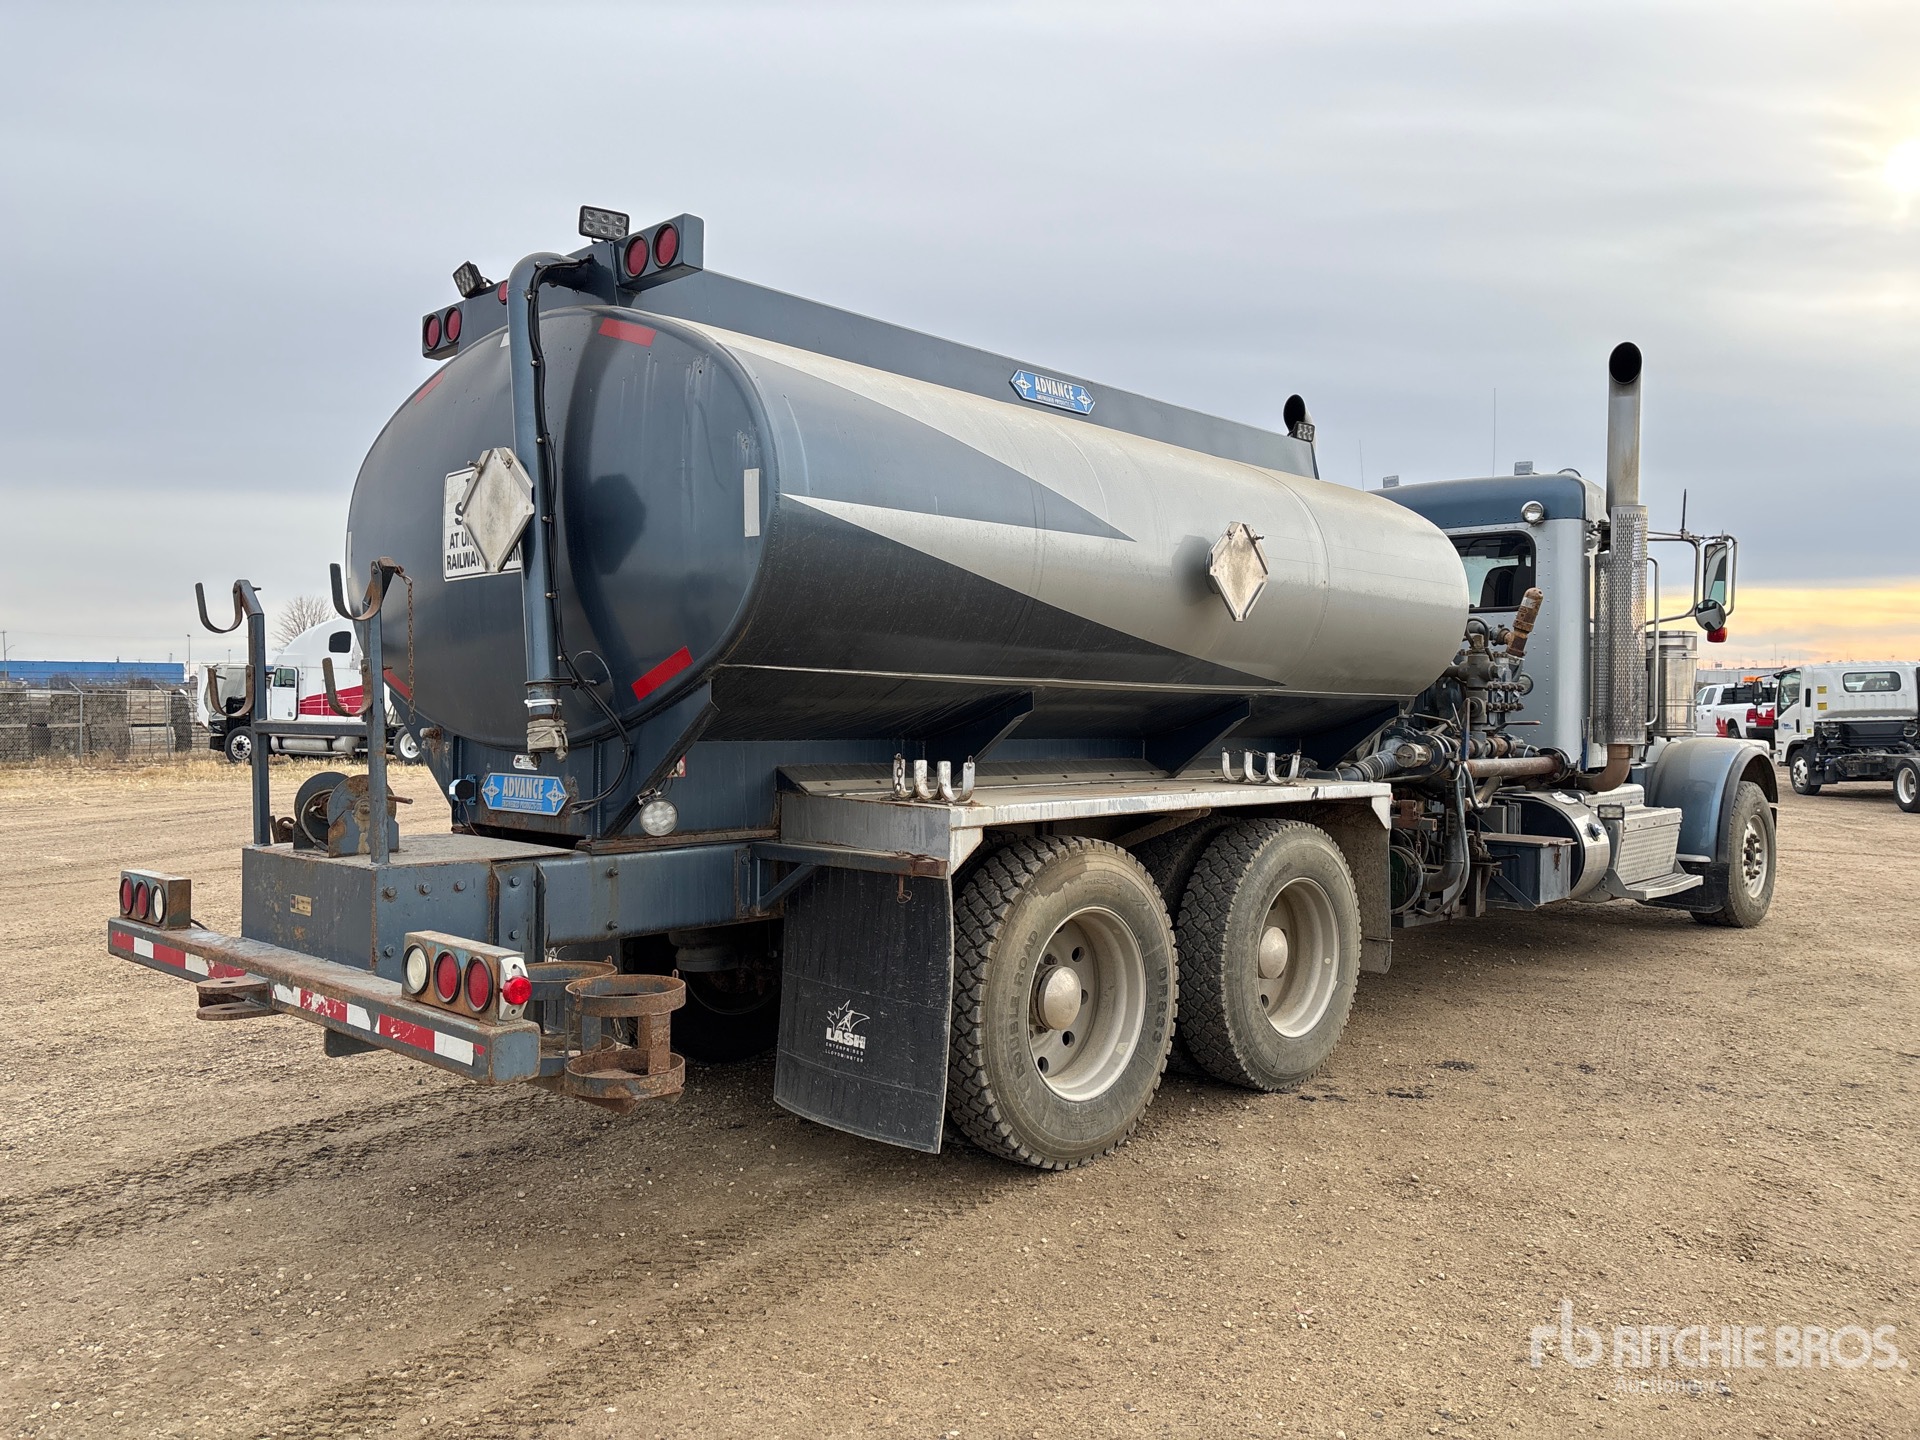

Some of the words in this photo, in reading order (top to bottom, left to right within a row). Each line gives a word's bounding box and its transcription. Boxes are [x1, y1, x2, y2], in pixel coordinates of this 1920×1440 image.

[1035, 377, 1075, 400] ADVANCE
[449, 533, 460, 549] AT
[502, 776, 545, 800] ADVANCE
[1014, 930, 1038, 987] ROAD
[826, 1027, 867, 1050] LASH
